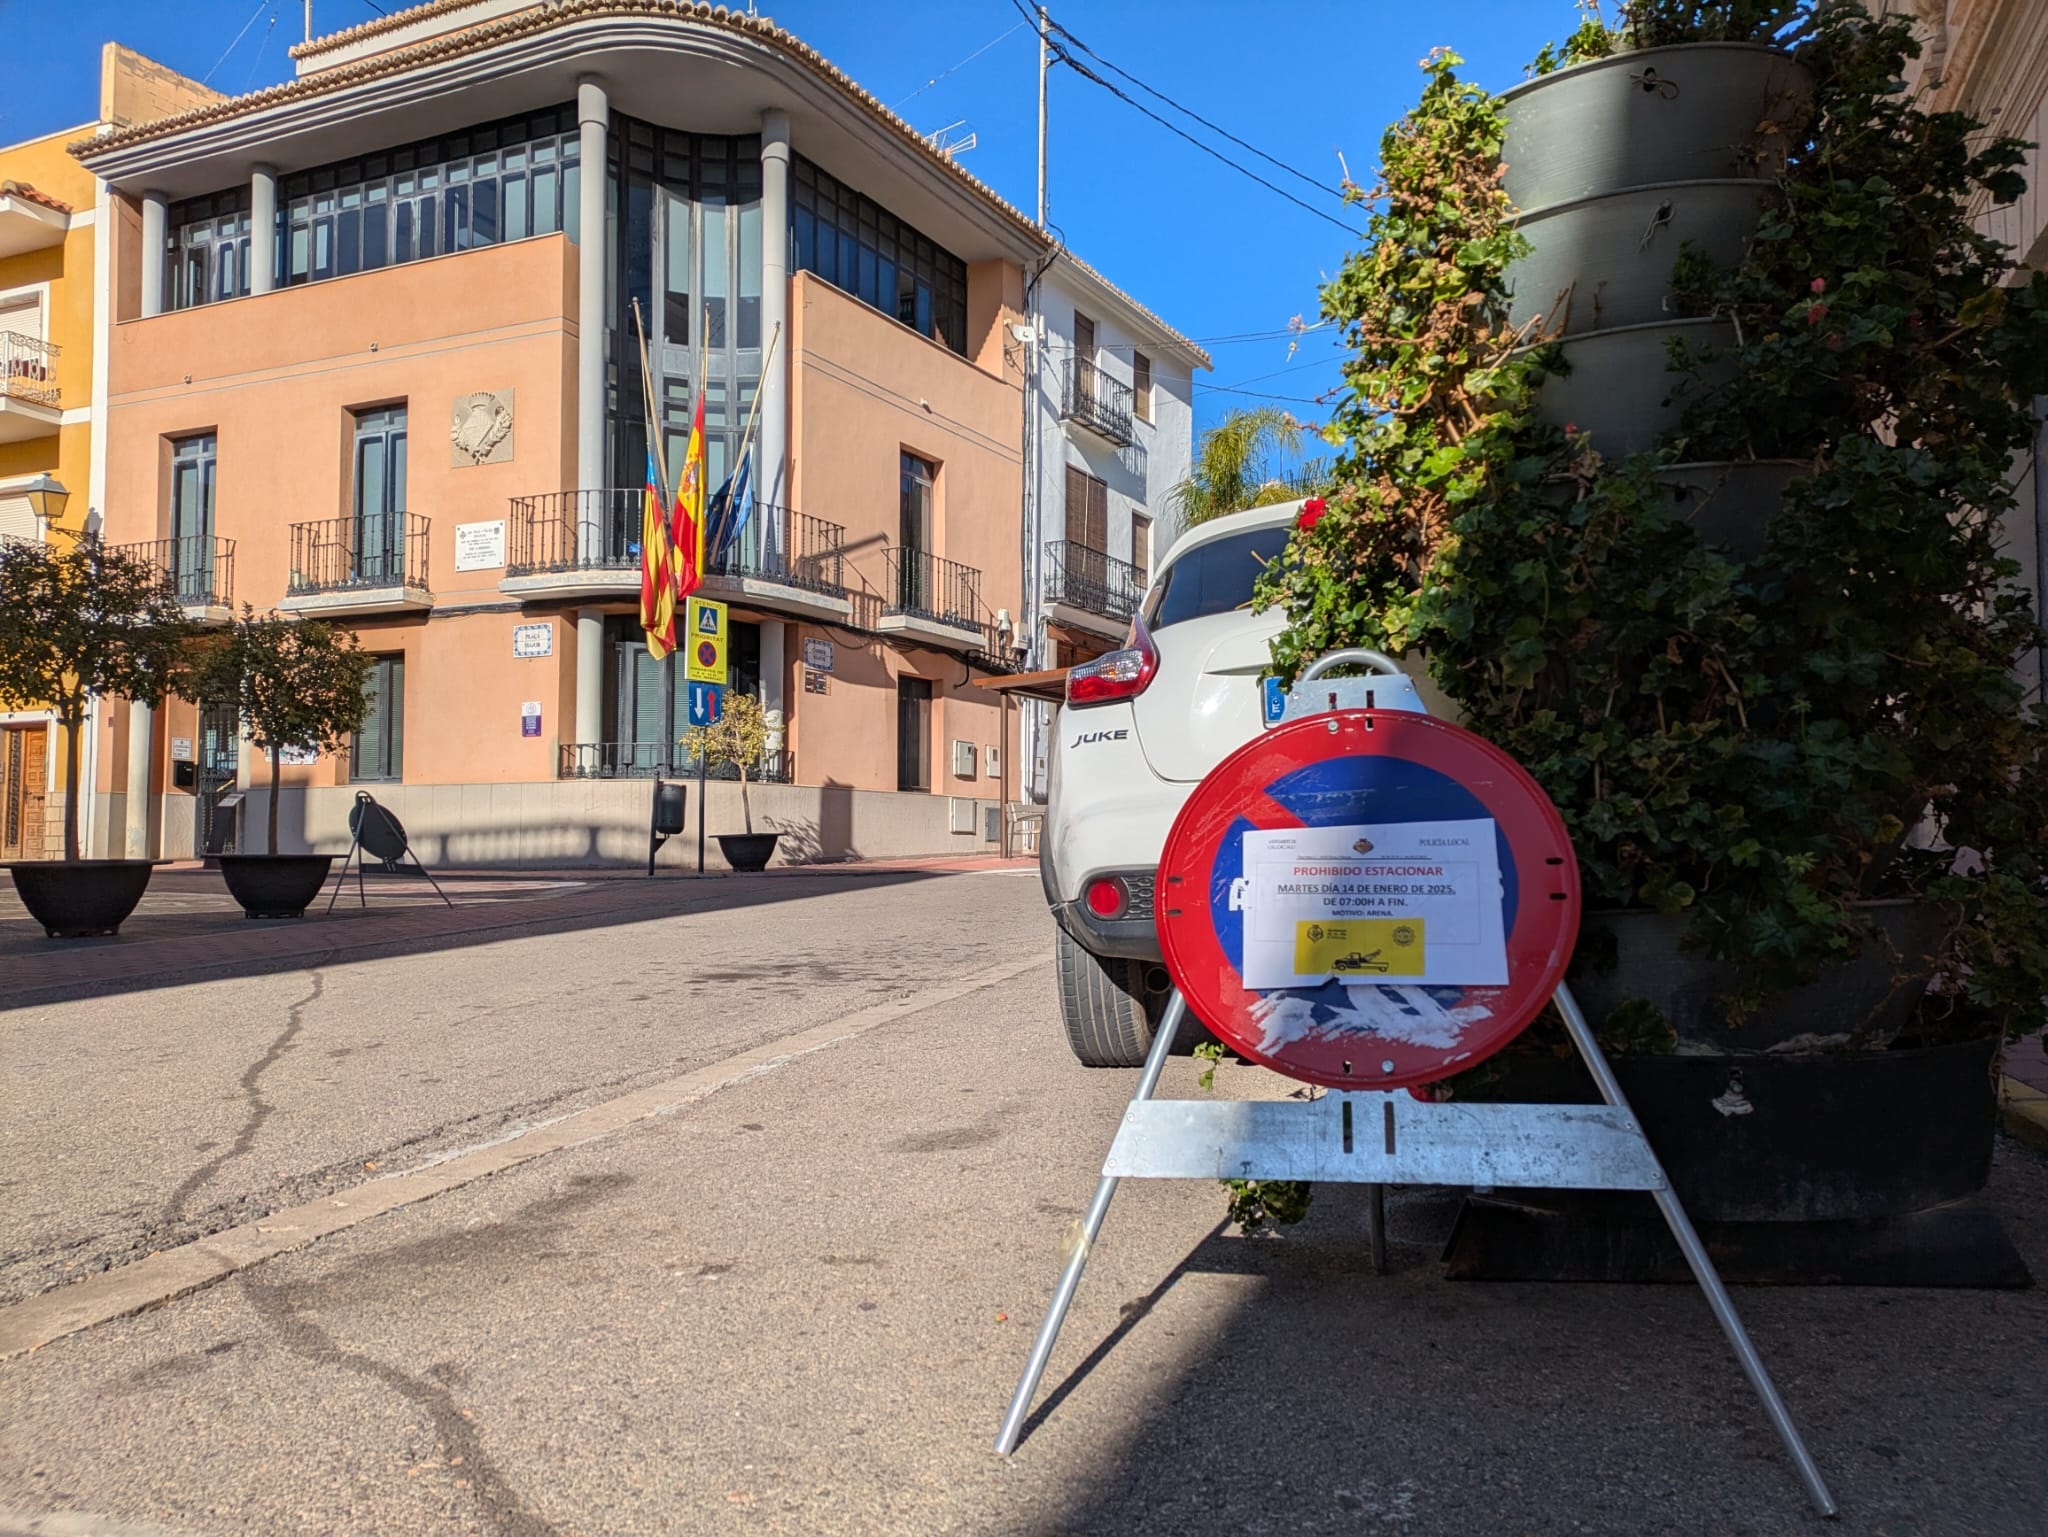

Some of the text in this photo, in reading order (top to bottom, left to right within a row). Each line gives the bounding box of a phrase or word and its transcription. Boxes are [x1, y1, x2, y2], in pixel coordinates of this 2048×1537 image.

[1071, 729, 1129, 748] JUKE
[1293, 866, 1443, 876] PROHIBIDO ESTACIONAR
[1277, 884, 1319, 893] MARTES
[1321, 882, 1340, 893] DÍA
[1342, 884, 1354, 893] 14
[1357, 884, 1371, 893] DE
[1373, 884, 1408, 893] ENERO
[1411, 884, 1425, 893] DE
[1323, 898, 1337, 906] DE
[1339, 897, 1375, 906] 07:00H
[1377, 898, 1386, 906] A
